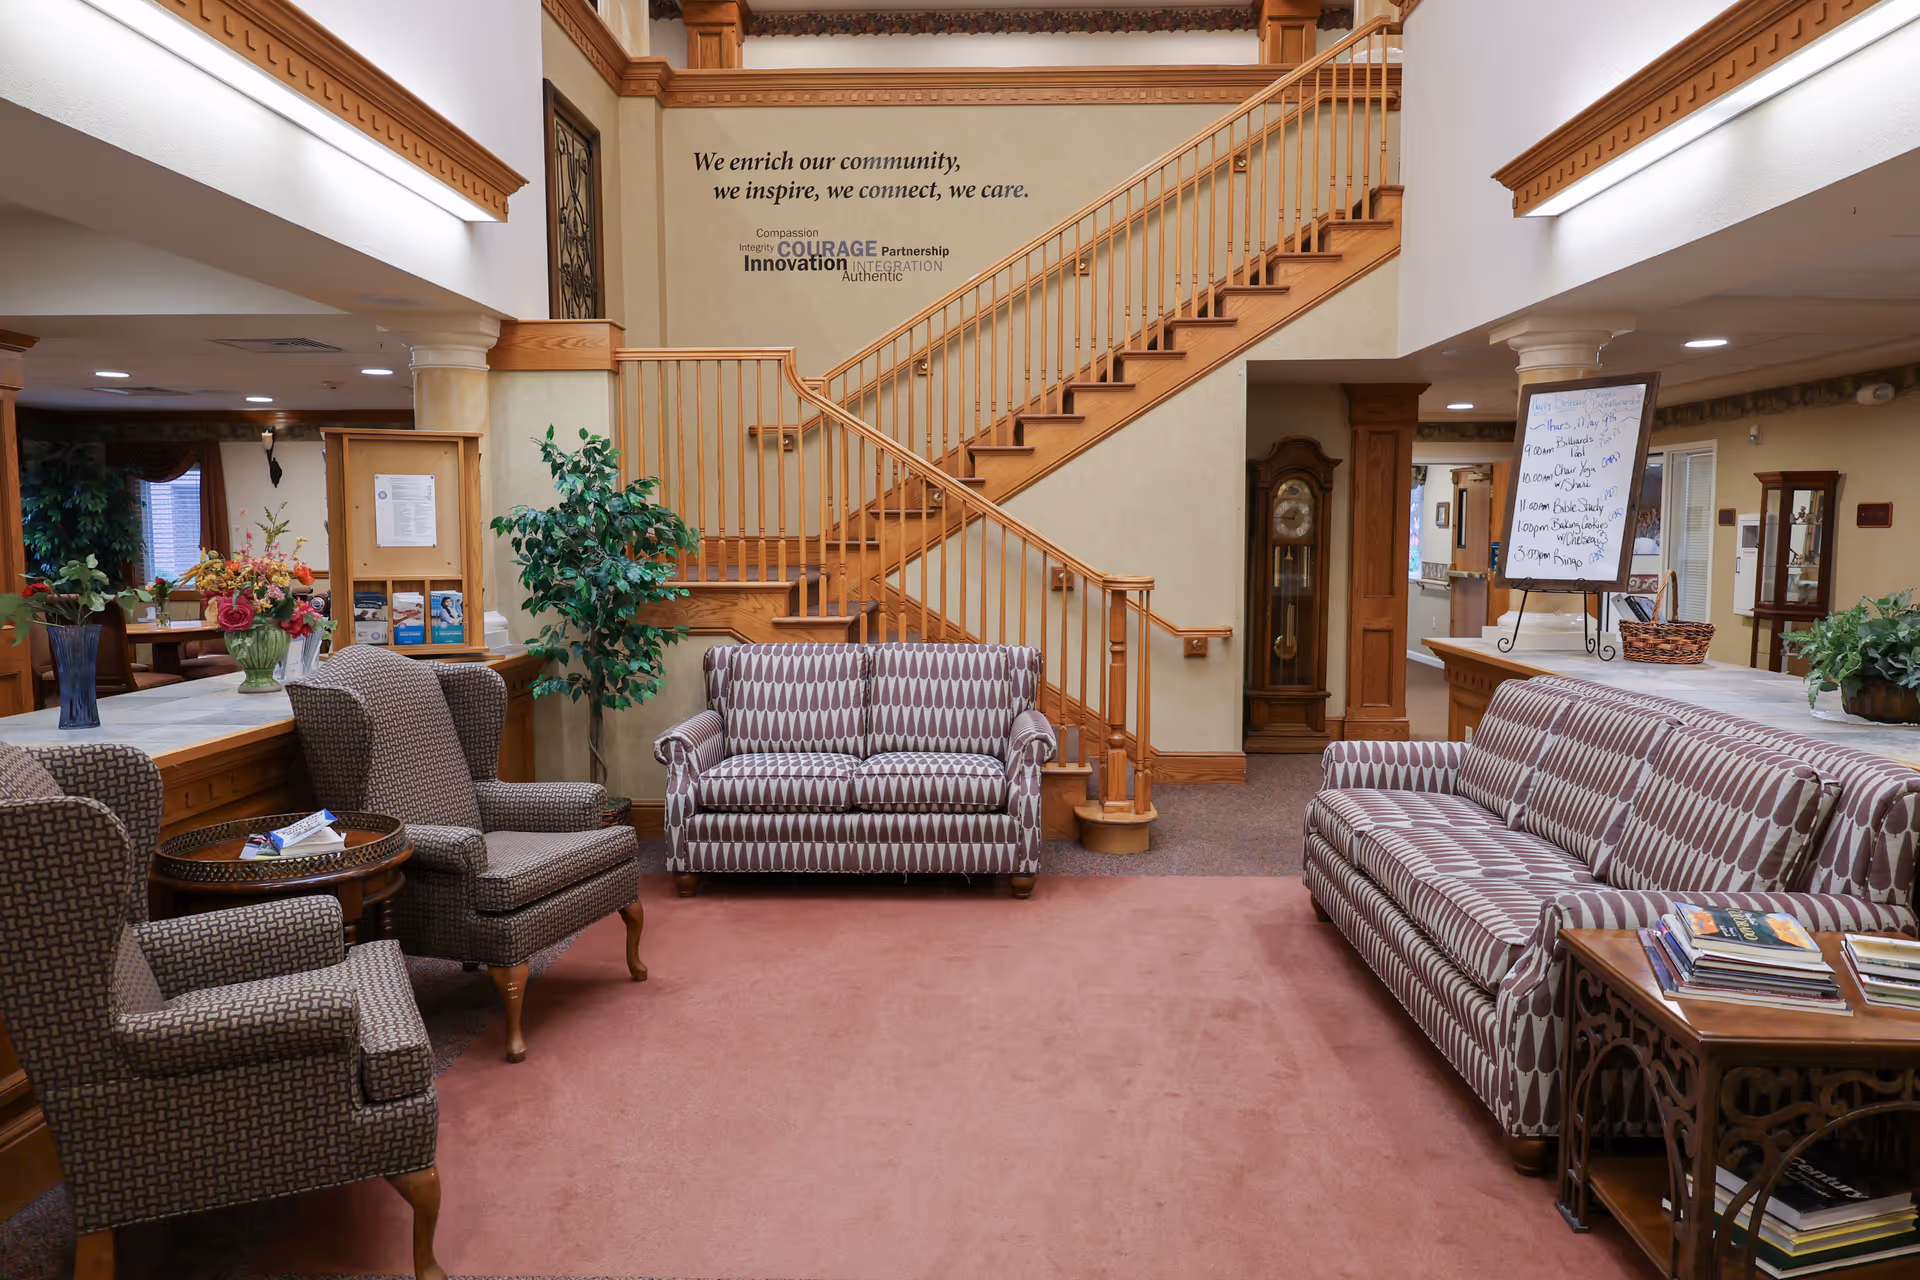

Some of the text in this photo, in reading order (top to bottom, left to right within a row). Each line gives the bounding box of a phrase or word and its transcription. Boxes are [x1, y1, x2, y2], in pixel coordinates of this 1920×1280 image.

[693, 150, 961, 175] We enrich our community,
[713, 180, 1029, 205] we inspire, we connect, we care.
[756, 227, 819, 240] Compassion
[739, 240, 950, 258] Integrity COURAGE Partnership
[743, 253, 943, 272] Innovation INTEGRATION
[841, 269, 903, 282] Authentic
[1556, 435, 1593, 448] Billiards
[1555, 464, 1577, 476] Chair
[1579, 459, 1596, 477] Yoga
[1553, 498, 1576, 514] Bible
[1577, 498, 1604, 516] Study
[1551, 518, 1580, 534] Baking
[1581, 515, 1608, 530] Cookies
